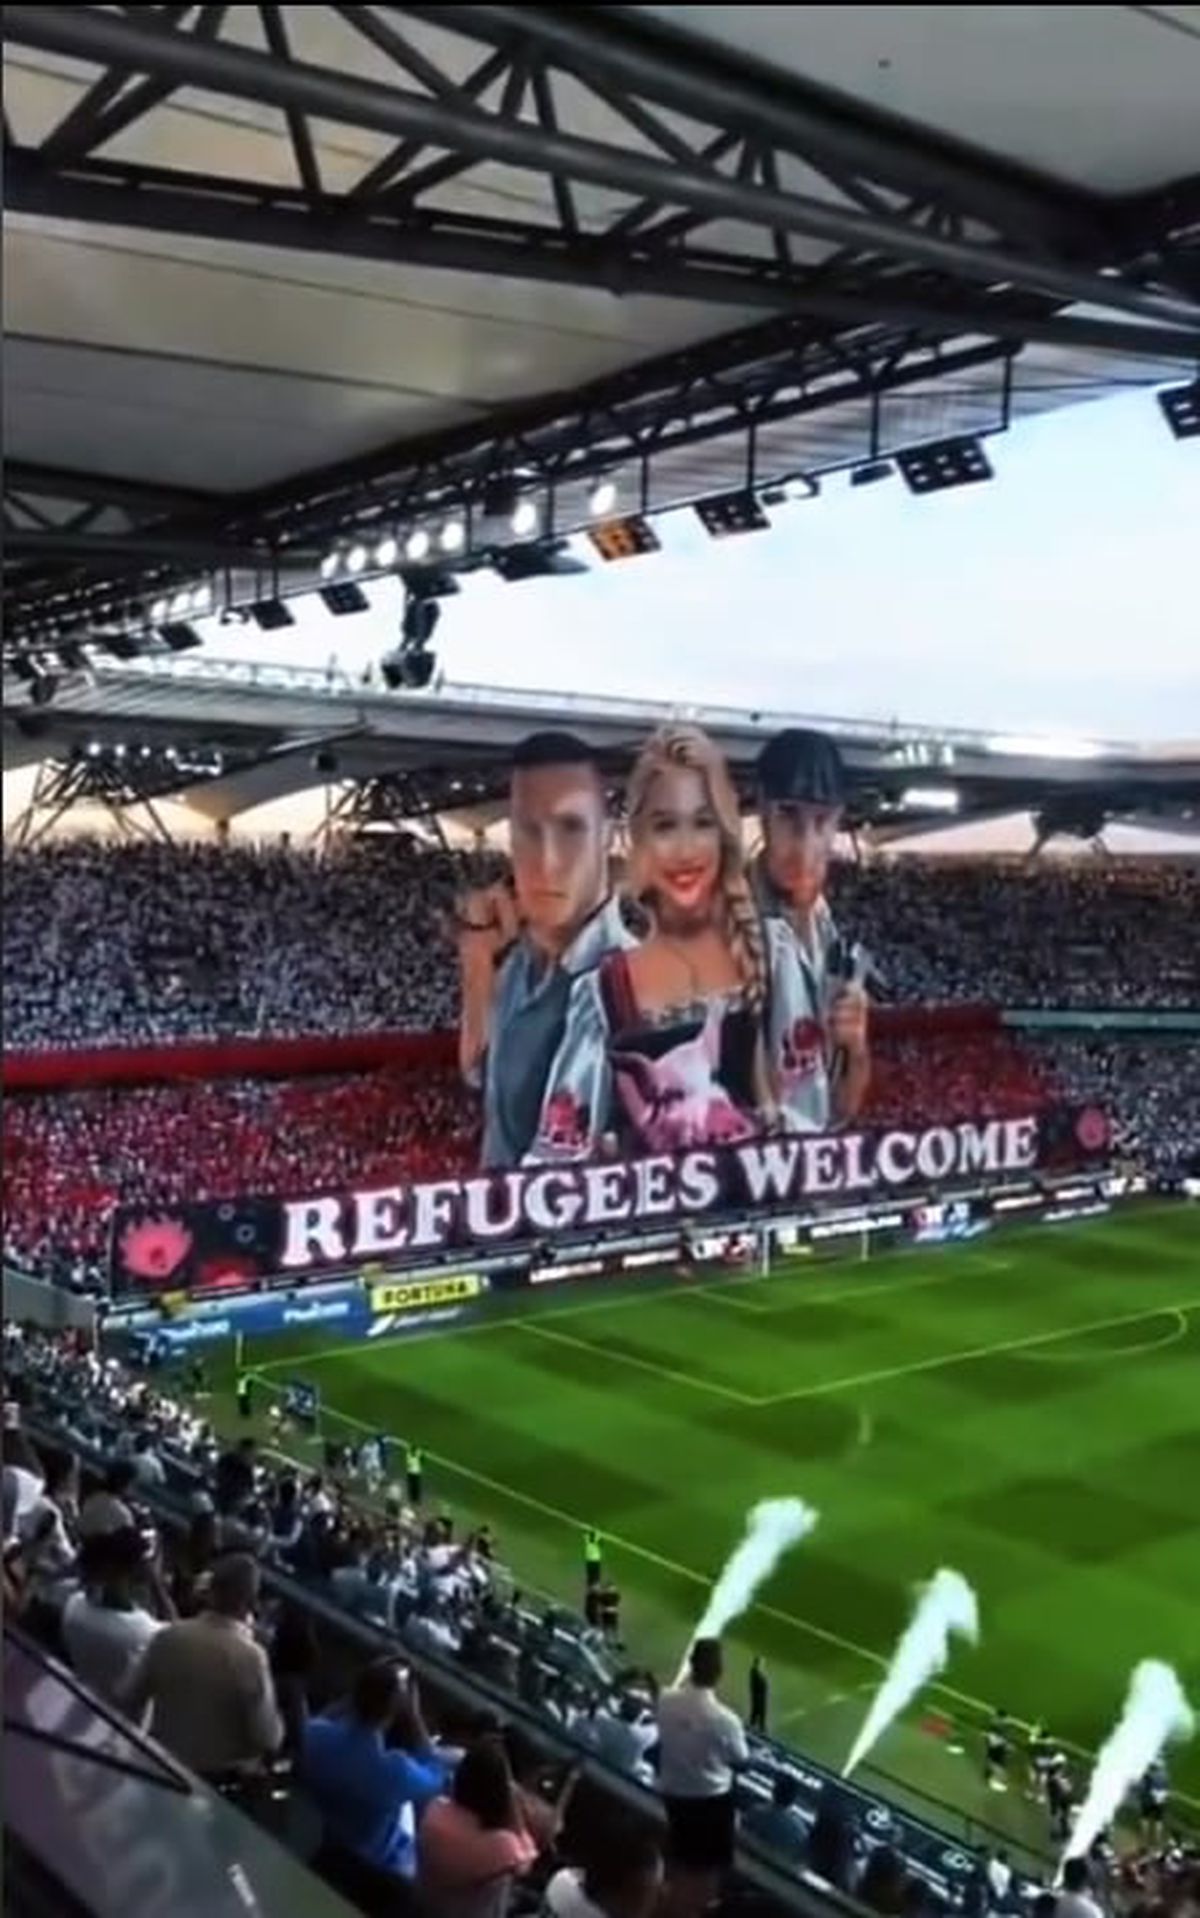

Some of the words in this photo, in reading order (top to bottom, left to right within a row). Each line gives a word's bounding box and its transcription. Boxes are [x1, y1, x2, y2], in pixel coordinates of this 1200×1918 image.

[281, 1153, 719, 1266] REFUGEES
[738, 1117, 1037, 1200] WELCOME
[383, 1281, 467, 1304] FORTUNA
